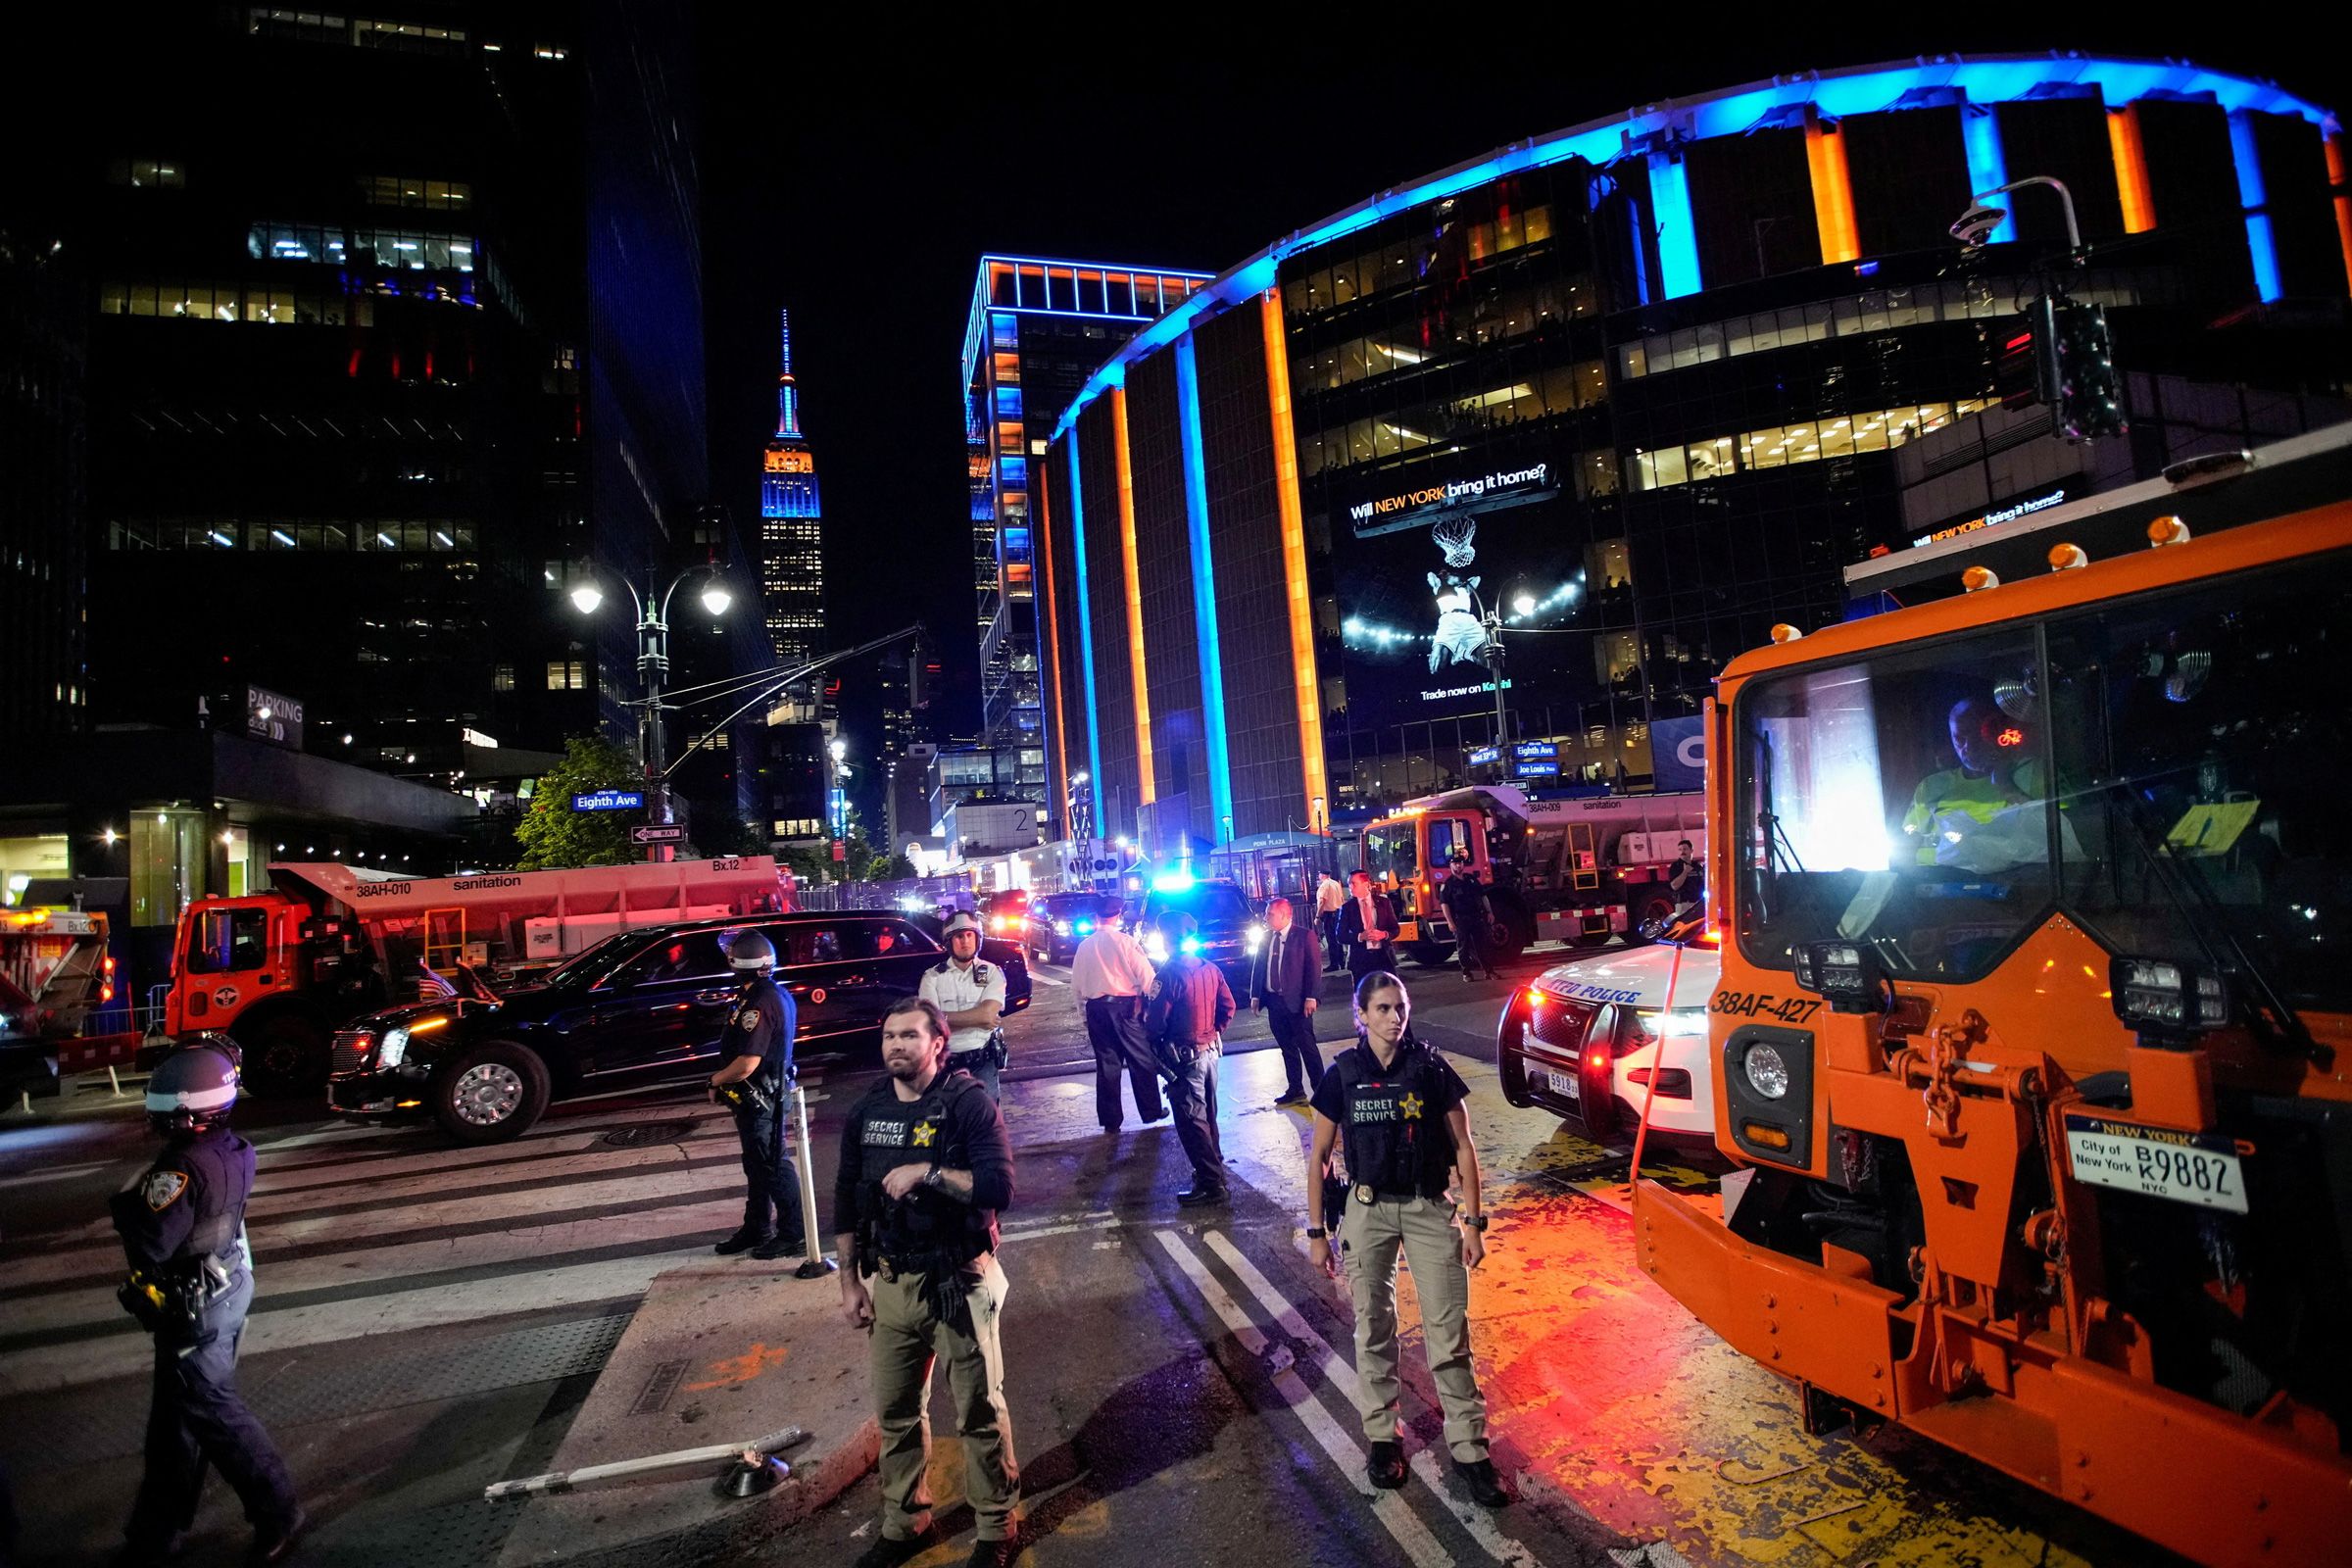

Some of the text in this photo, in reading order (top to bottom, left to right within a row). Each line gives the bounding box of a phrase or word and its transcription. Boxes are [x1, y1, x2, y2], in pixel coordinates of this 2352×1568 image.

[1350, 464, 1546, 519] Will NEW YORK bring it home?
[1957, 517, 1986, 535] YORK
[1985, 511, 2016, 526] bring
[1421, 679, 1511, 701] Trade now on Kahi
[249, 689, 302, 722] PARKING
[1517, 746, 1553, 757] Eighth Ave
[1530, 764, 1544, 773] Louis
[577, 795, 637, 809] Eighth Ave
[1529, 803, 1561, 813] 38AH-009
[1583, 800, 1622, 810] sanitation
[1014, 808, 1028, 831] 2
[712, 859, 740, 871] Bx.12
[356, 883, 412, 898] 38AH-010
[453, 875, 521, 891] sanitation
[1546, 979, 1642, 1004] NYPD POLICE
[1710, 991, 1823, 1024] 38AF-427
[1550, 1073, 1571, 1091] 5918
[1354, 1099, 1394, 1111] SECRET
[1353, 1110, 1396, 1123] SERVICE
[867, 1121, 906, 1134] SECRET
[2103, 1122, 2190, 1147] NEW YORK
[863, 1133, 905, 1146] SERVICE
[2082, 1140, 2121, 1155] City of
[2076, 1153, 2133, 1174] New York
[2141, 1182, 2168, 1195] NYC
